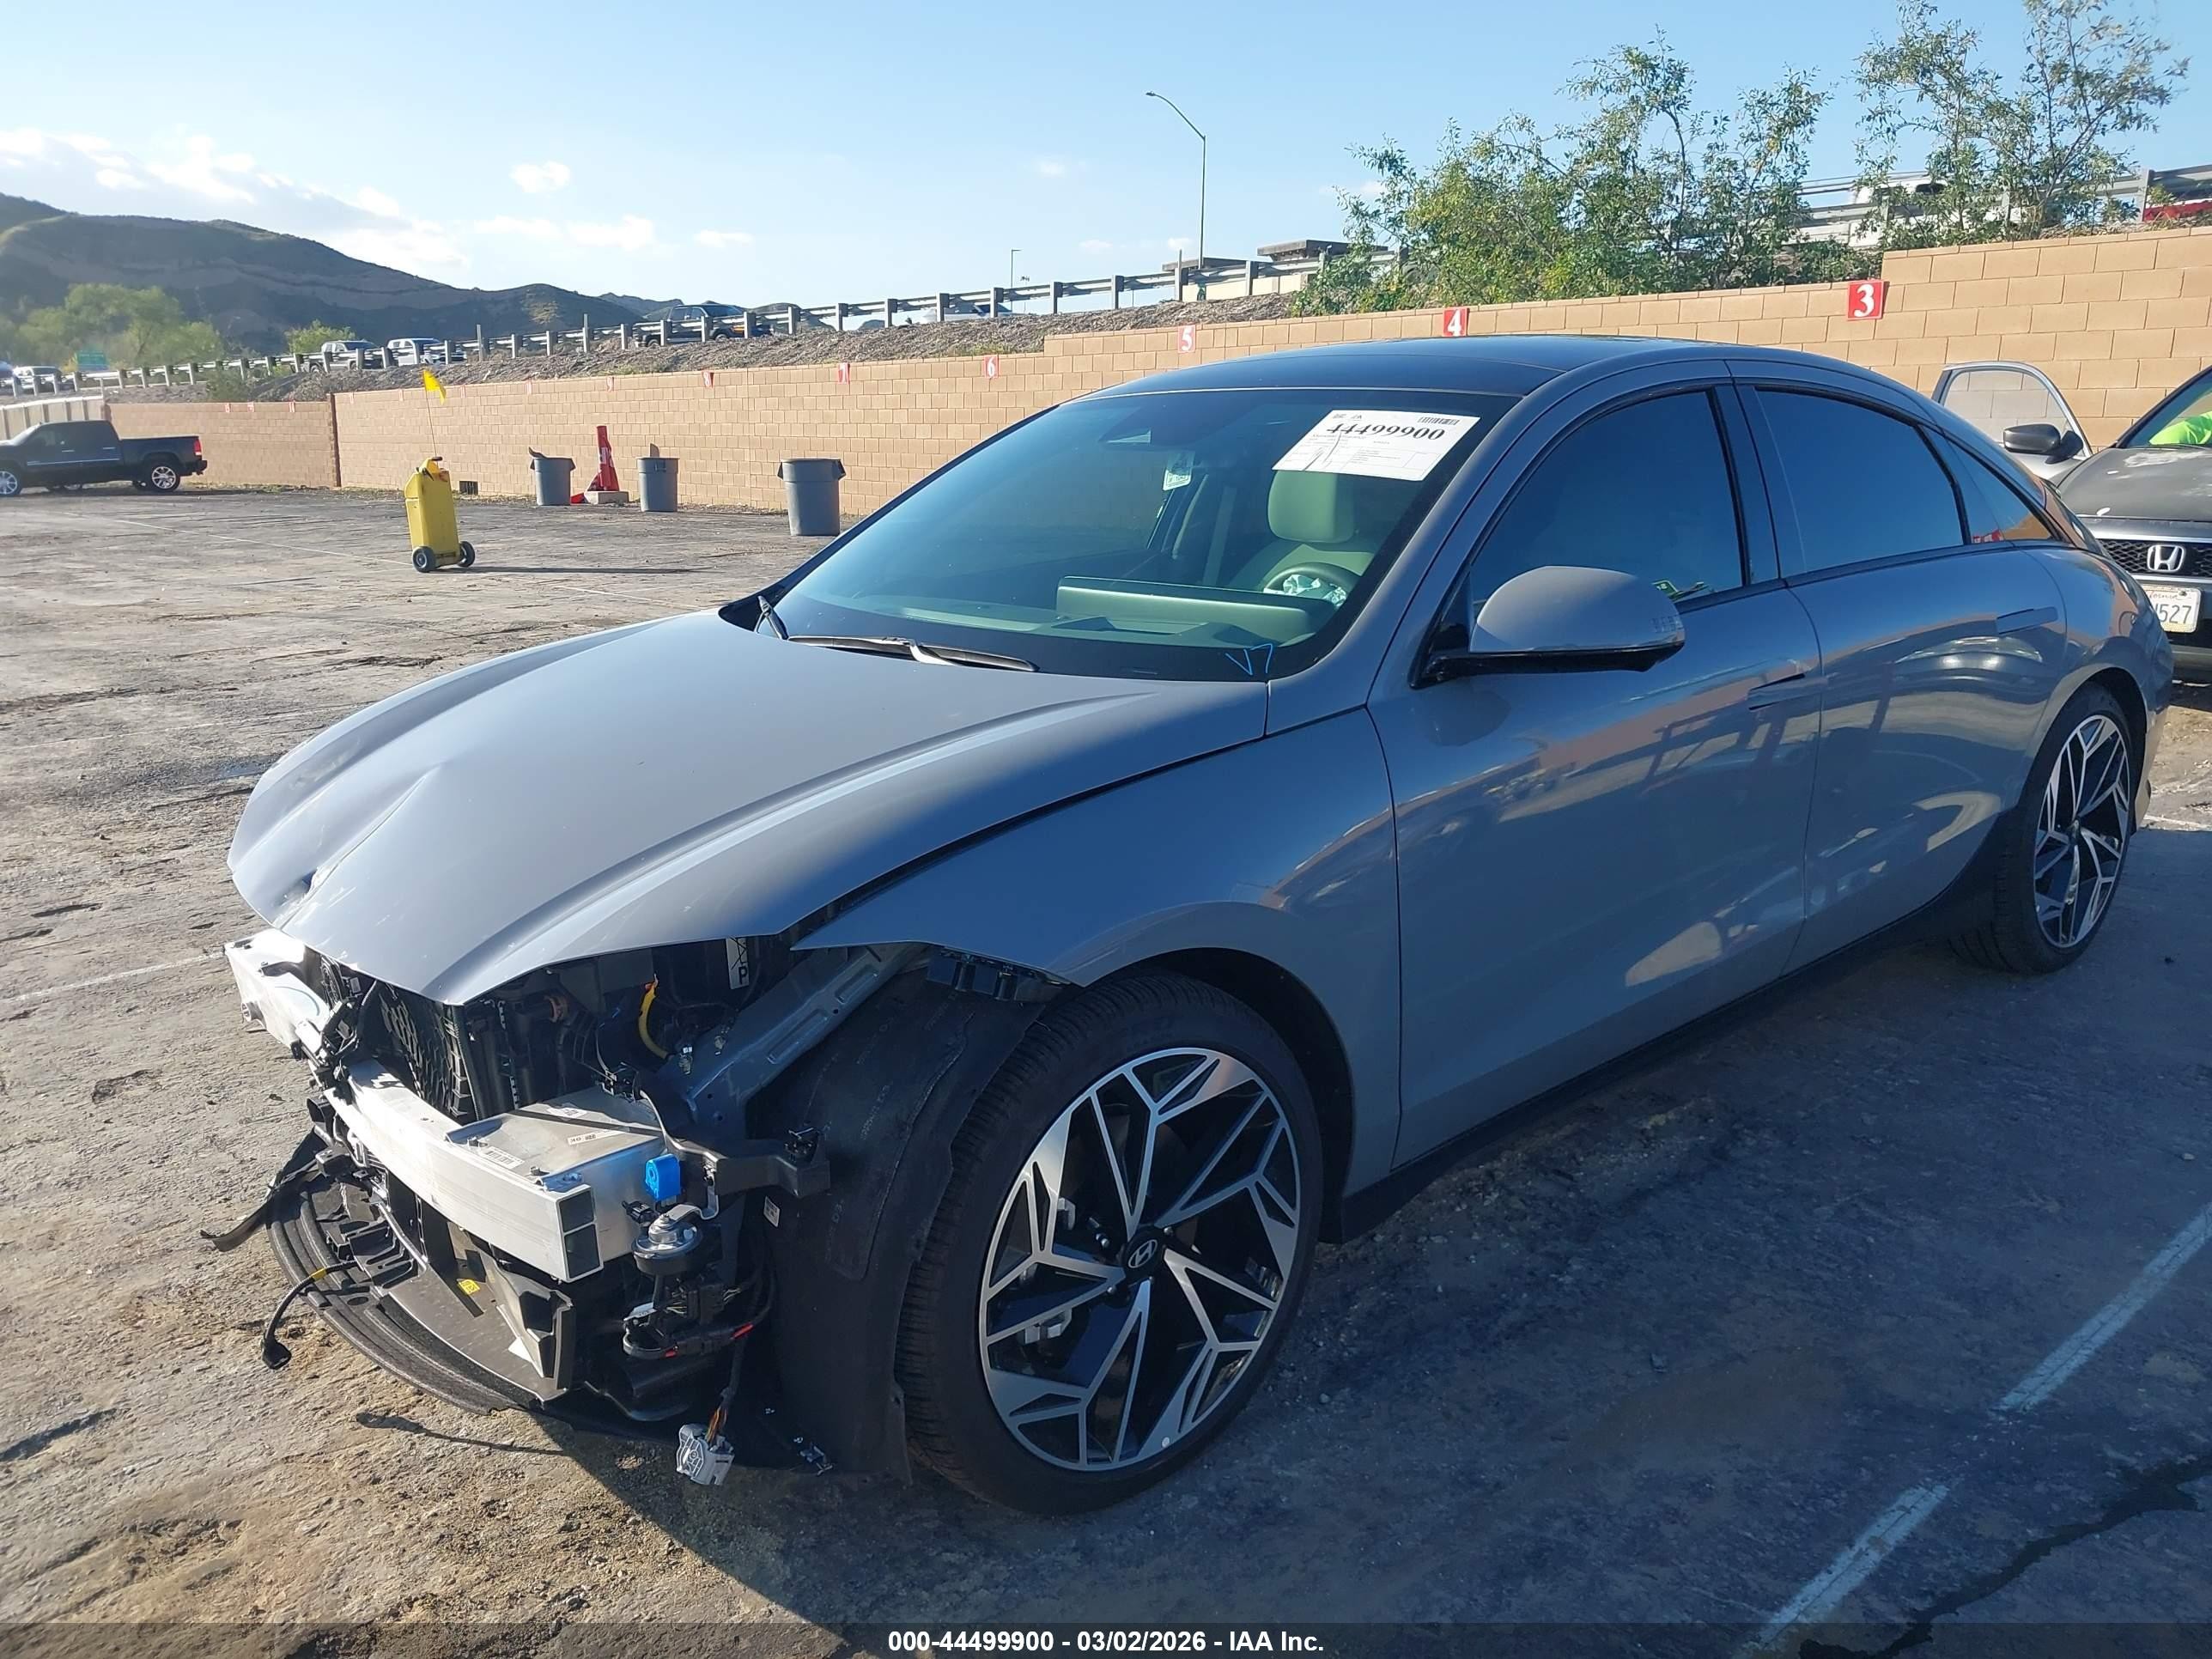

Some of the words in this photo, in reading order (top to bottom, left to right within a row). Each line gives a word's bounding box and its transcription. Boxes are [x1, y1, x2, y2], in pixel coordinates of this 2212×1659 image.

[1853, 283, 1875, 318] 3
[1447, 308, 1462, 337] 4
[1181, 326, 1193, 351] 5
[987, 356, 995, 377] 6
[1326, 422, 1445, 441] 44499900
[2154, 603, 2191, 624] 527
